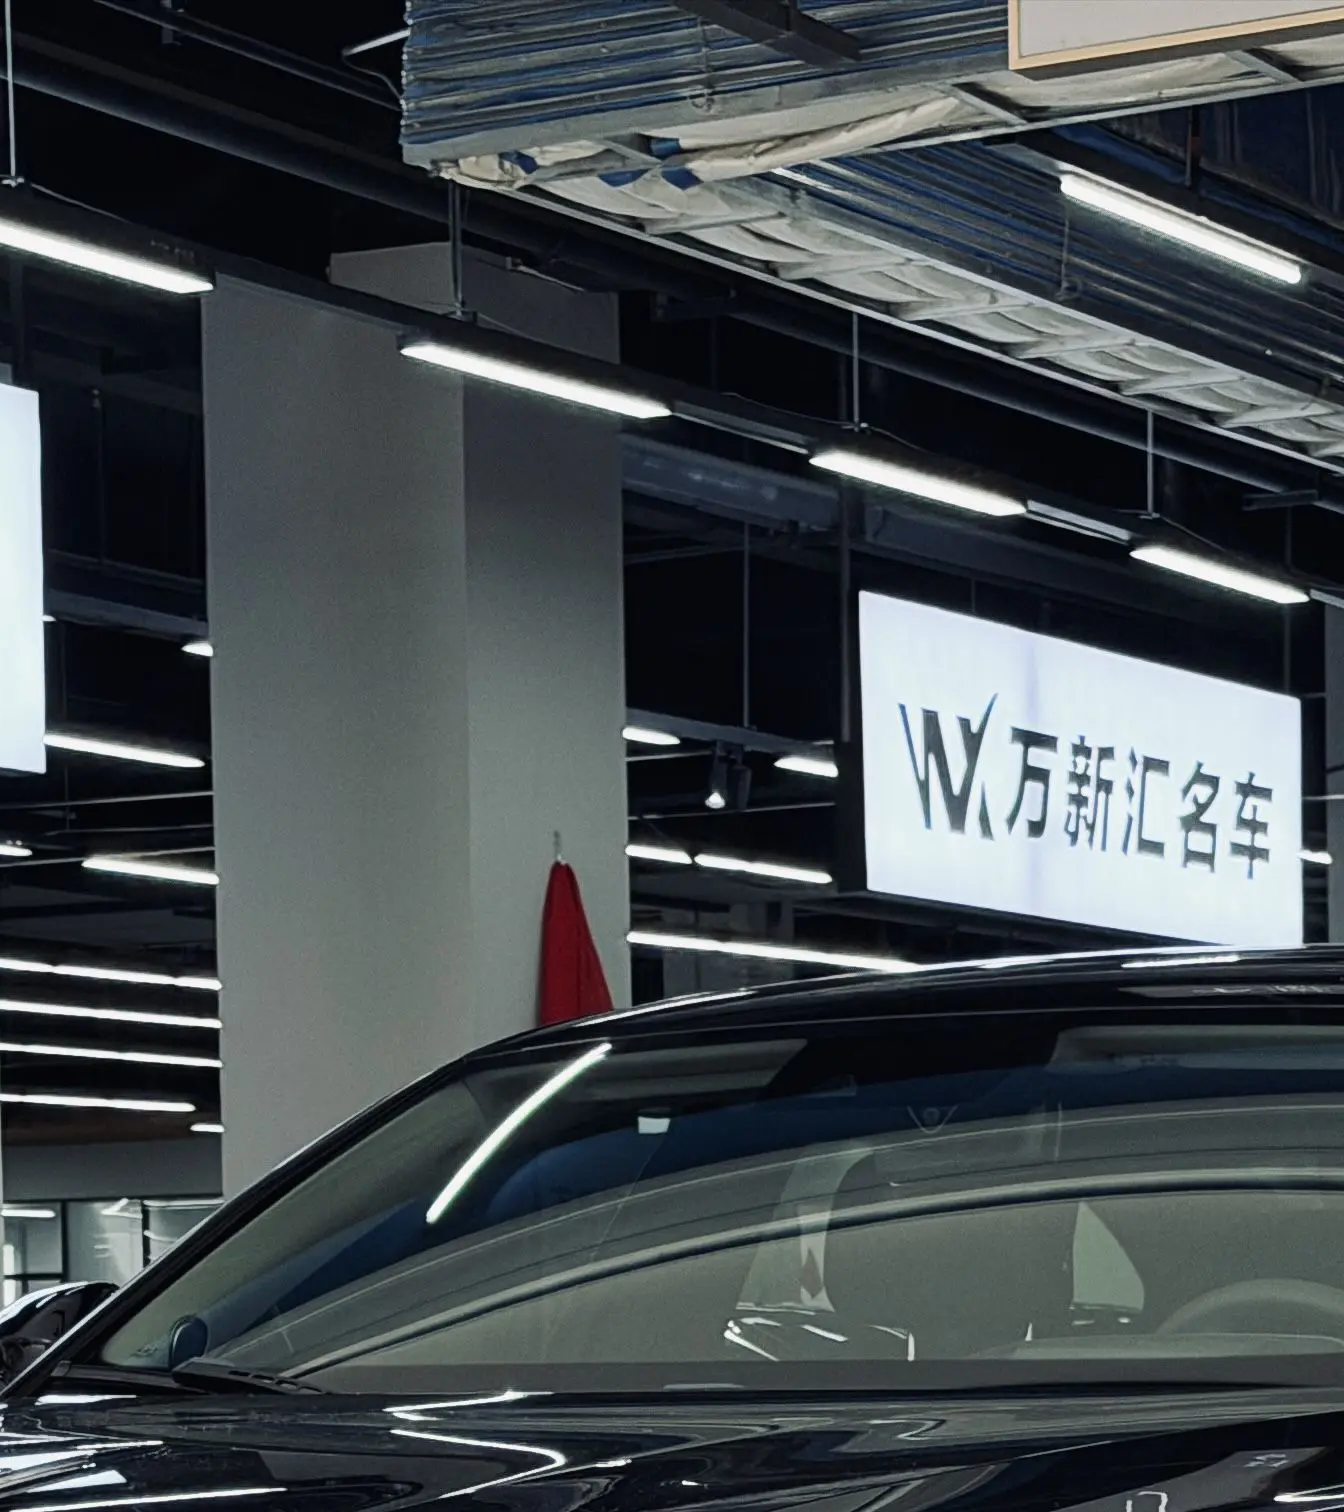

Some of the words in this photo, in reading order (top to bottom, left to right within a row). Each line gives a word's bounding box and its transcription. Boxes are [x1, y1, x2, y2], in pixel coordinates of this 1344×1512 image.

[1006, 726, 1273, 880] 万新汇名车
